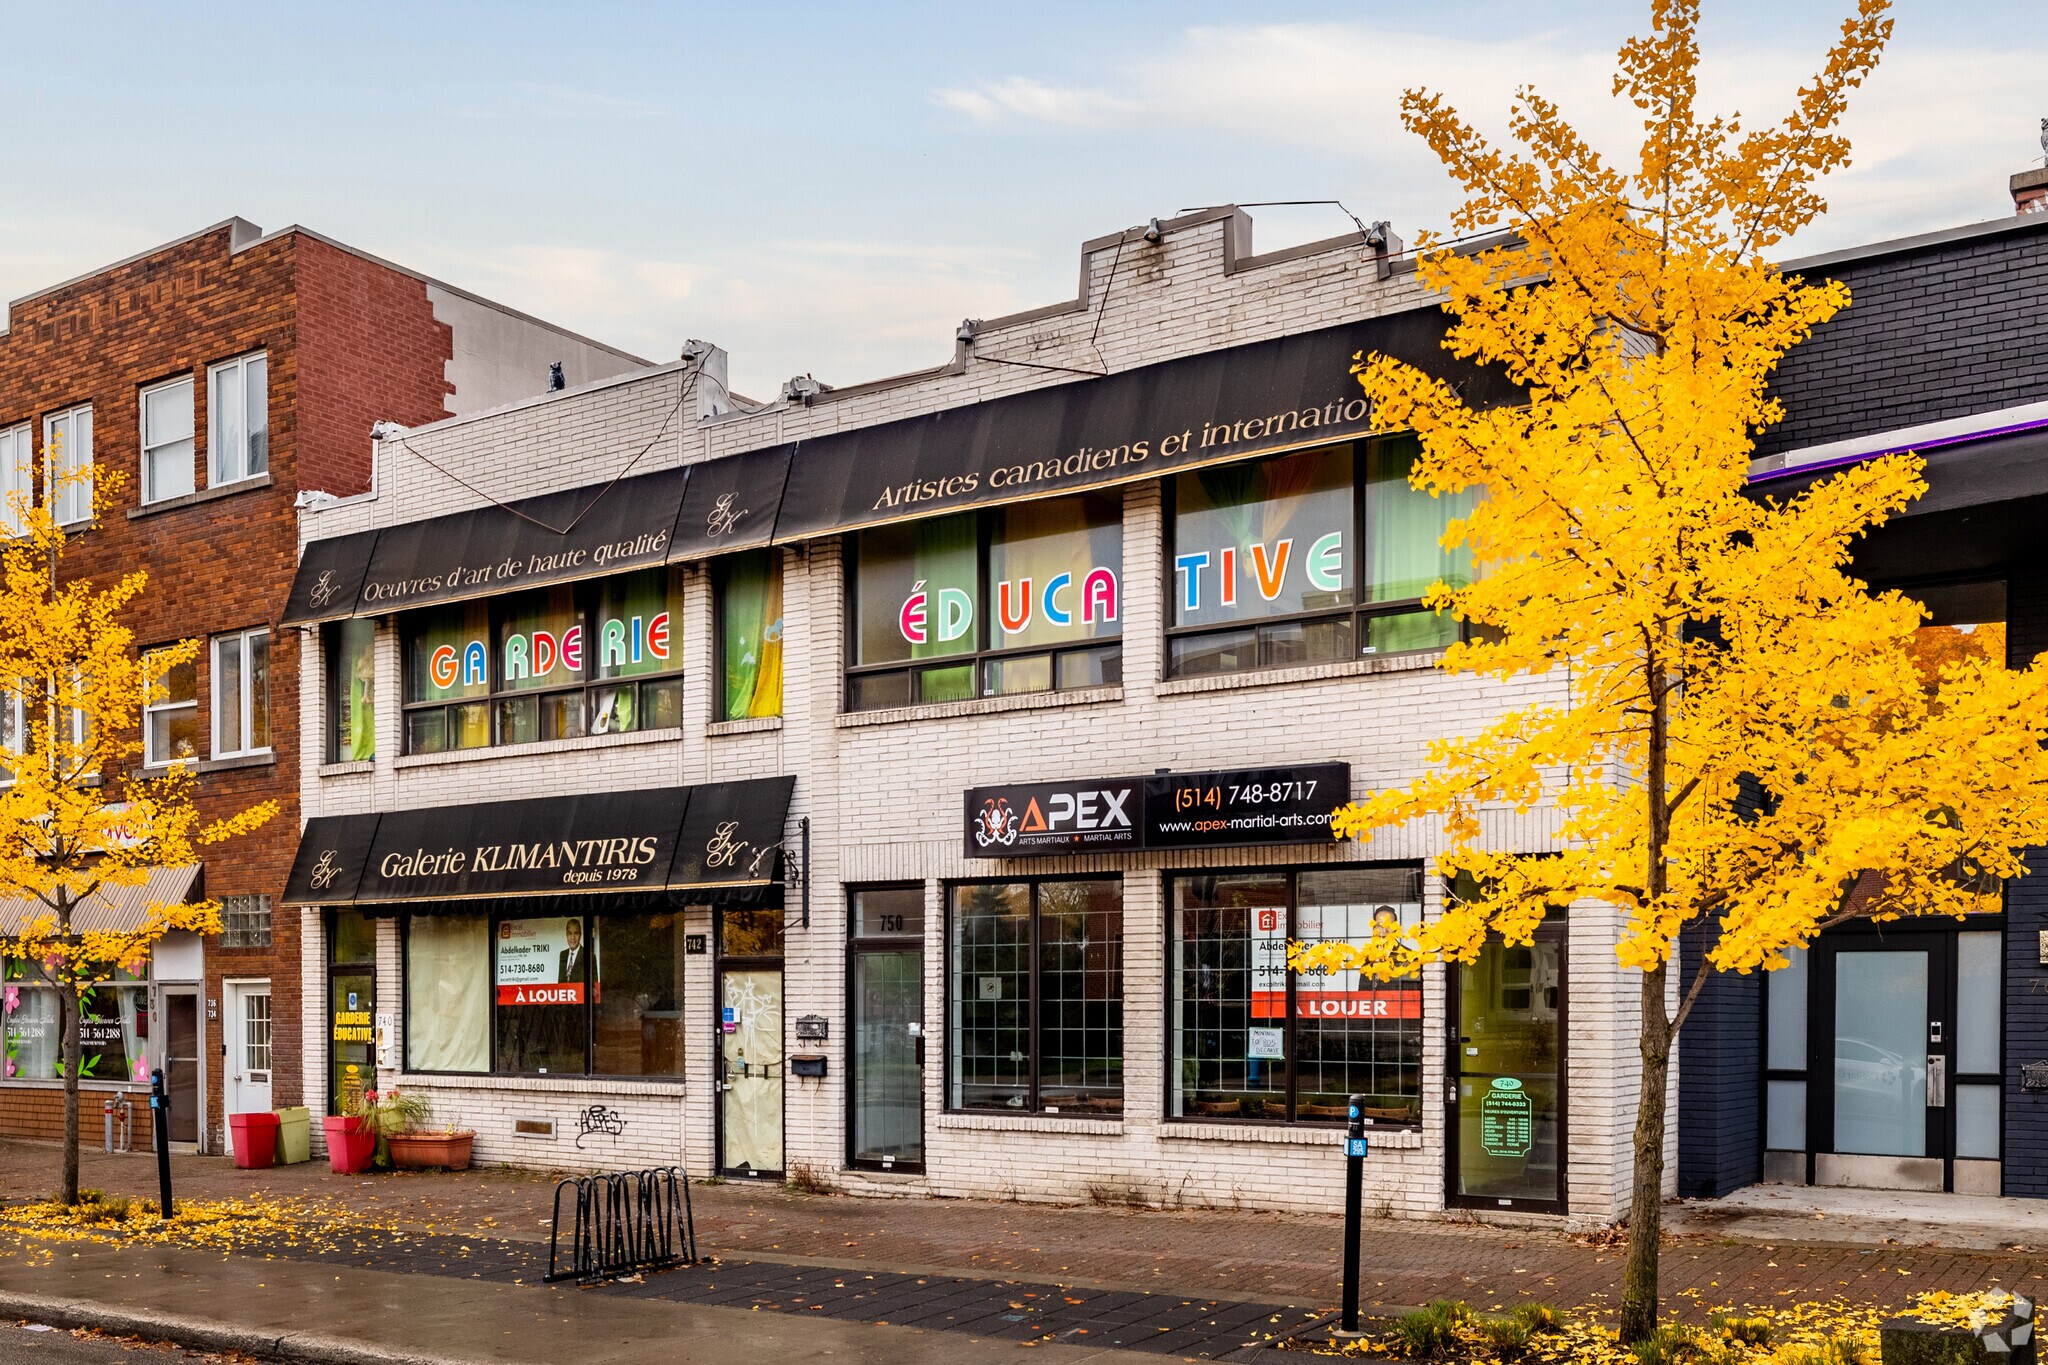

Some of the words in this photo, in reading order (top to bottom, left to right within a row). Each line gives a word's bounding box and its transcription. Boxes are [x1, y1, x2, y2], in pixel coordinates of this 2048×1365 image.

[872, 472, 979, 510] Artistes
[989, 440, 1149, 488] canadiens
[1160, 430, 1192, 457] et
[364, 575, 442, 601] Oeuvres
[446, 566, 492, 588] d'art
[496, 557, 523, 579] de
[527, 549, 586, 574] haute
[594, 529, 667, 565] qualité
[1175, 786, 1221, 812] (514)
[1229, 780, 1317, 805] 748-8717
[1019, 789, 1132, 832] APEX
[1159, 813, 1337, 833] www.apex-martial-arts.com
[1019, 838, 1036, 846] ARTS
[1036, 836, 1070, 844] MARTIAUX
[1084, 834, 1113, 842] MARTIAL
[1113, 832, 1132, 840] ARTS
[380, 847, 465, 878] Galerie
[471, 837, 658, 873] KLIMANTIRIS
[563, 868, 603, 885] depuis
[606, 868, 638, 881] 1978
[880, 914, 903, 932] 750
[501, 945, 531, 954] Abdelkader
[532, 944, 550, 953] TRIKI
[686, 938, 702, 950] 742
[500, 963, 545, 974] 514-730-8680
[515, 986, 526, 1002] À
[529, 989, 577, 1002] LOUER
[1309, 1000, 1388, 1016] LOUER
[335, 1011, 371, 1025] GARDERIE
[333, 1024, 372, 1041] ÉDUCATIVE
